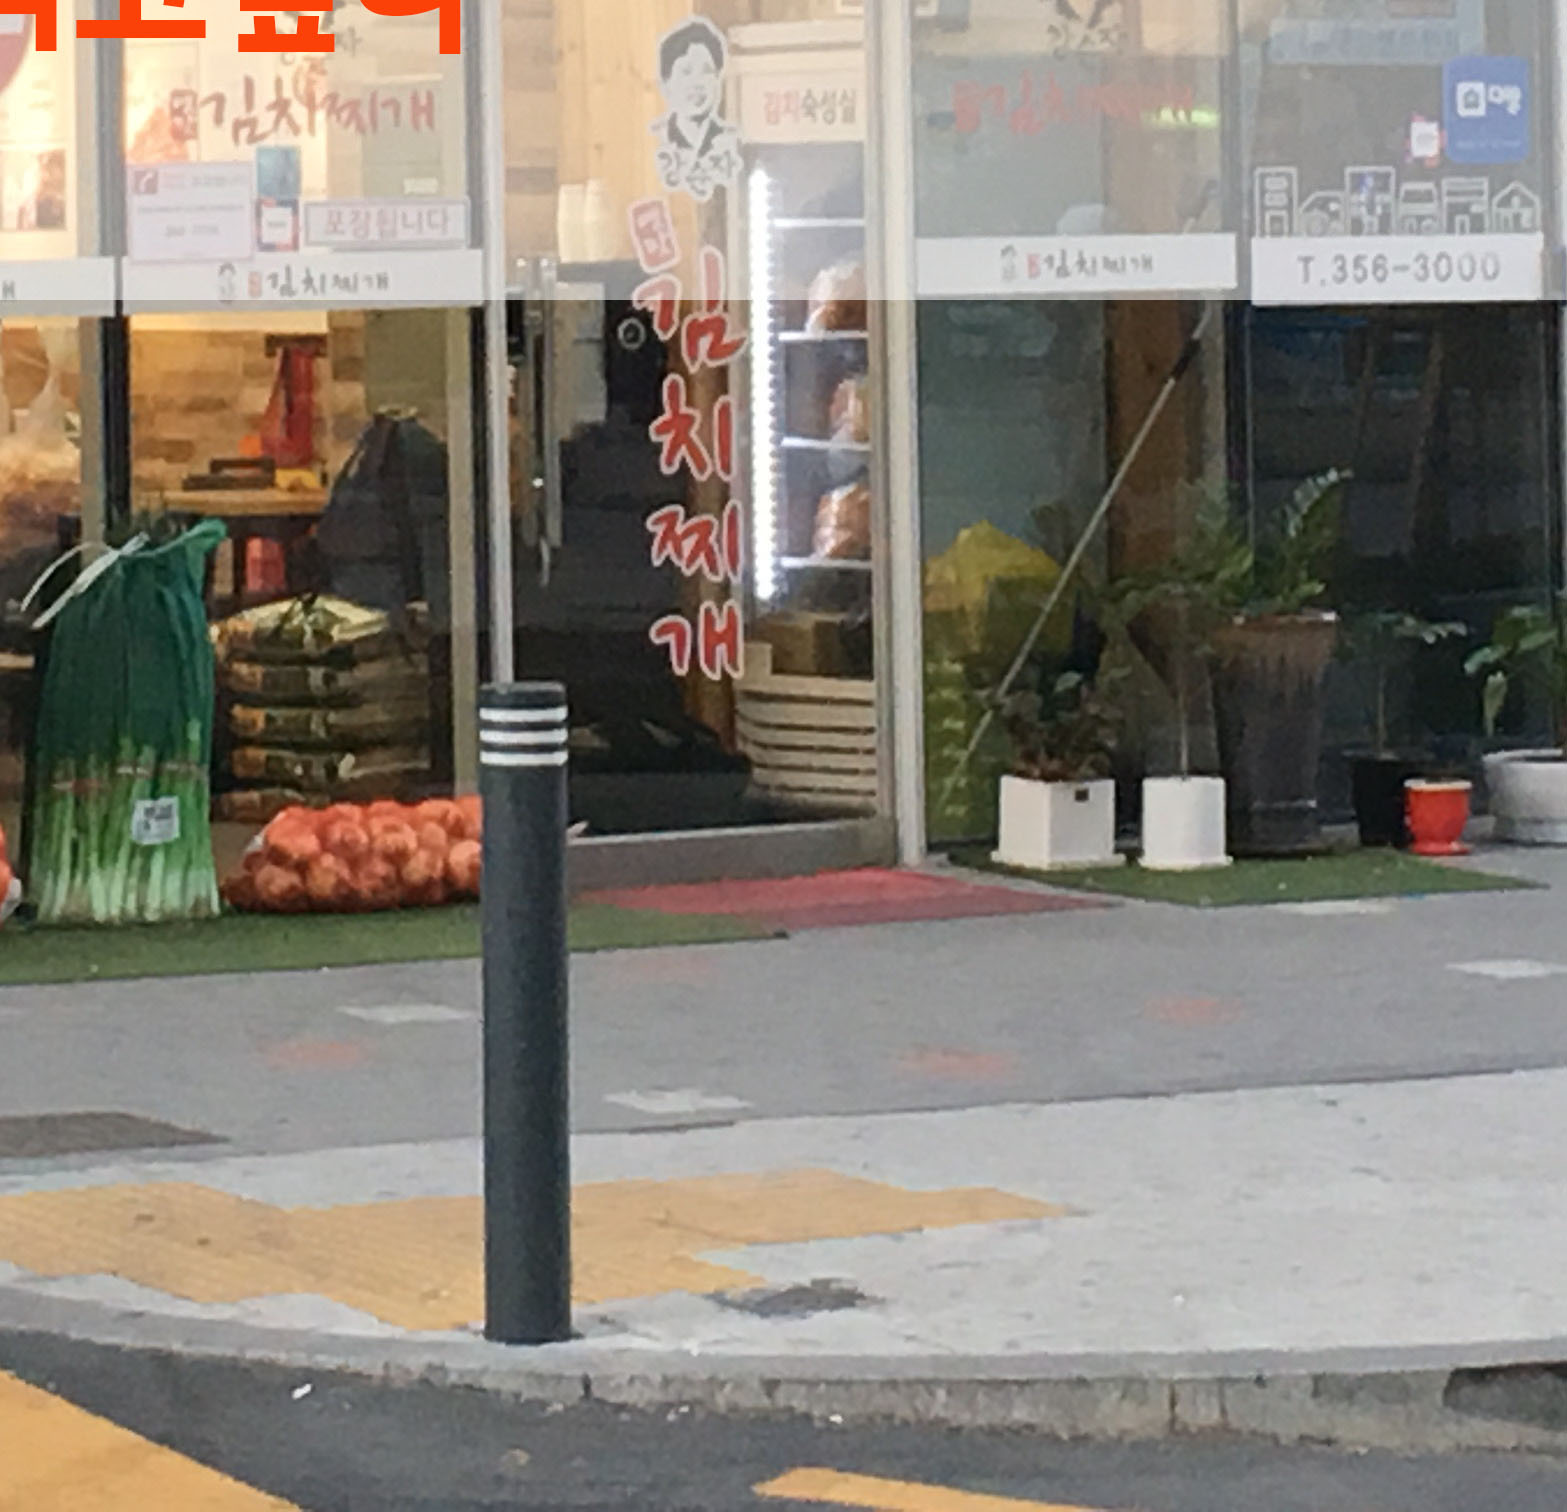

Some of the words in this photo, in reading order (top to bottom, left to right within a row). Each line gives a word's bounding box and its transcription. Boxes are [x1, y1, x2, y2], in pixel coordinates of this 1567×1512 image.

[199, 75, 436, 146] 김치찌개
[1297, 252, 1502, 287] T.356-3000
[634, 245, 747, 680] 김치찌개
